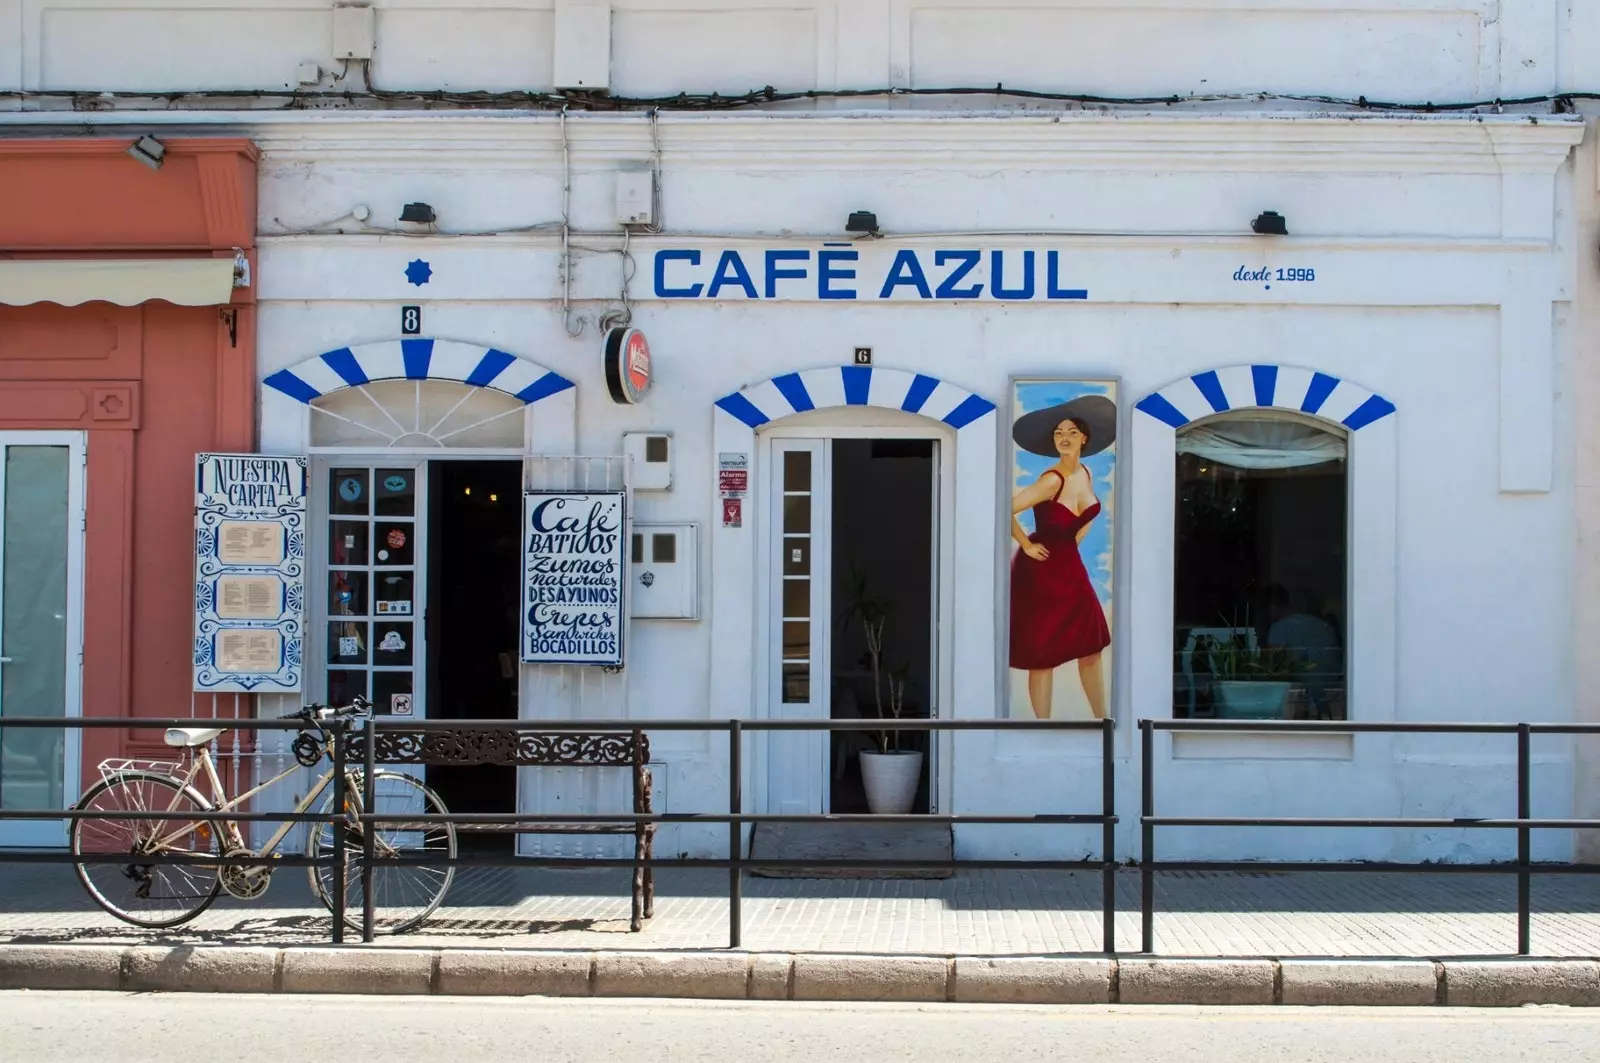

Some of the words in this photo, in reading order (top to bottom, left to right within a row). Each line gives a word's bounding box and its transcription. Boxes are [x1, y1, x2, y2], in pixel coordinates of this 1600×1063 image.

[879, 250, 1088, 299] AZUL
[1233, 264, 1272, 281] desde
[405, 309, 418, 331] 8
[858, 350, 868, 362] 6
[213, 459, 292, 496] NUESTRA
[229, 483, 277, 508] CARTA
[531, 496, 619, 538] Café
[528, 533, 618, 554] BATIDOS
[529, 571, 617, 587] naturales
[528, 586, 618, 603] DESAYUNOS
[527, 602, 616, 630] Crepes
[531, 639, 616, 654] BOCADILLOS
